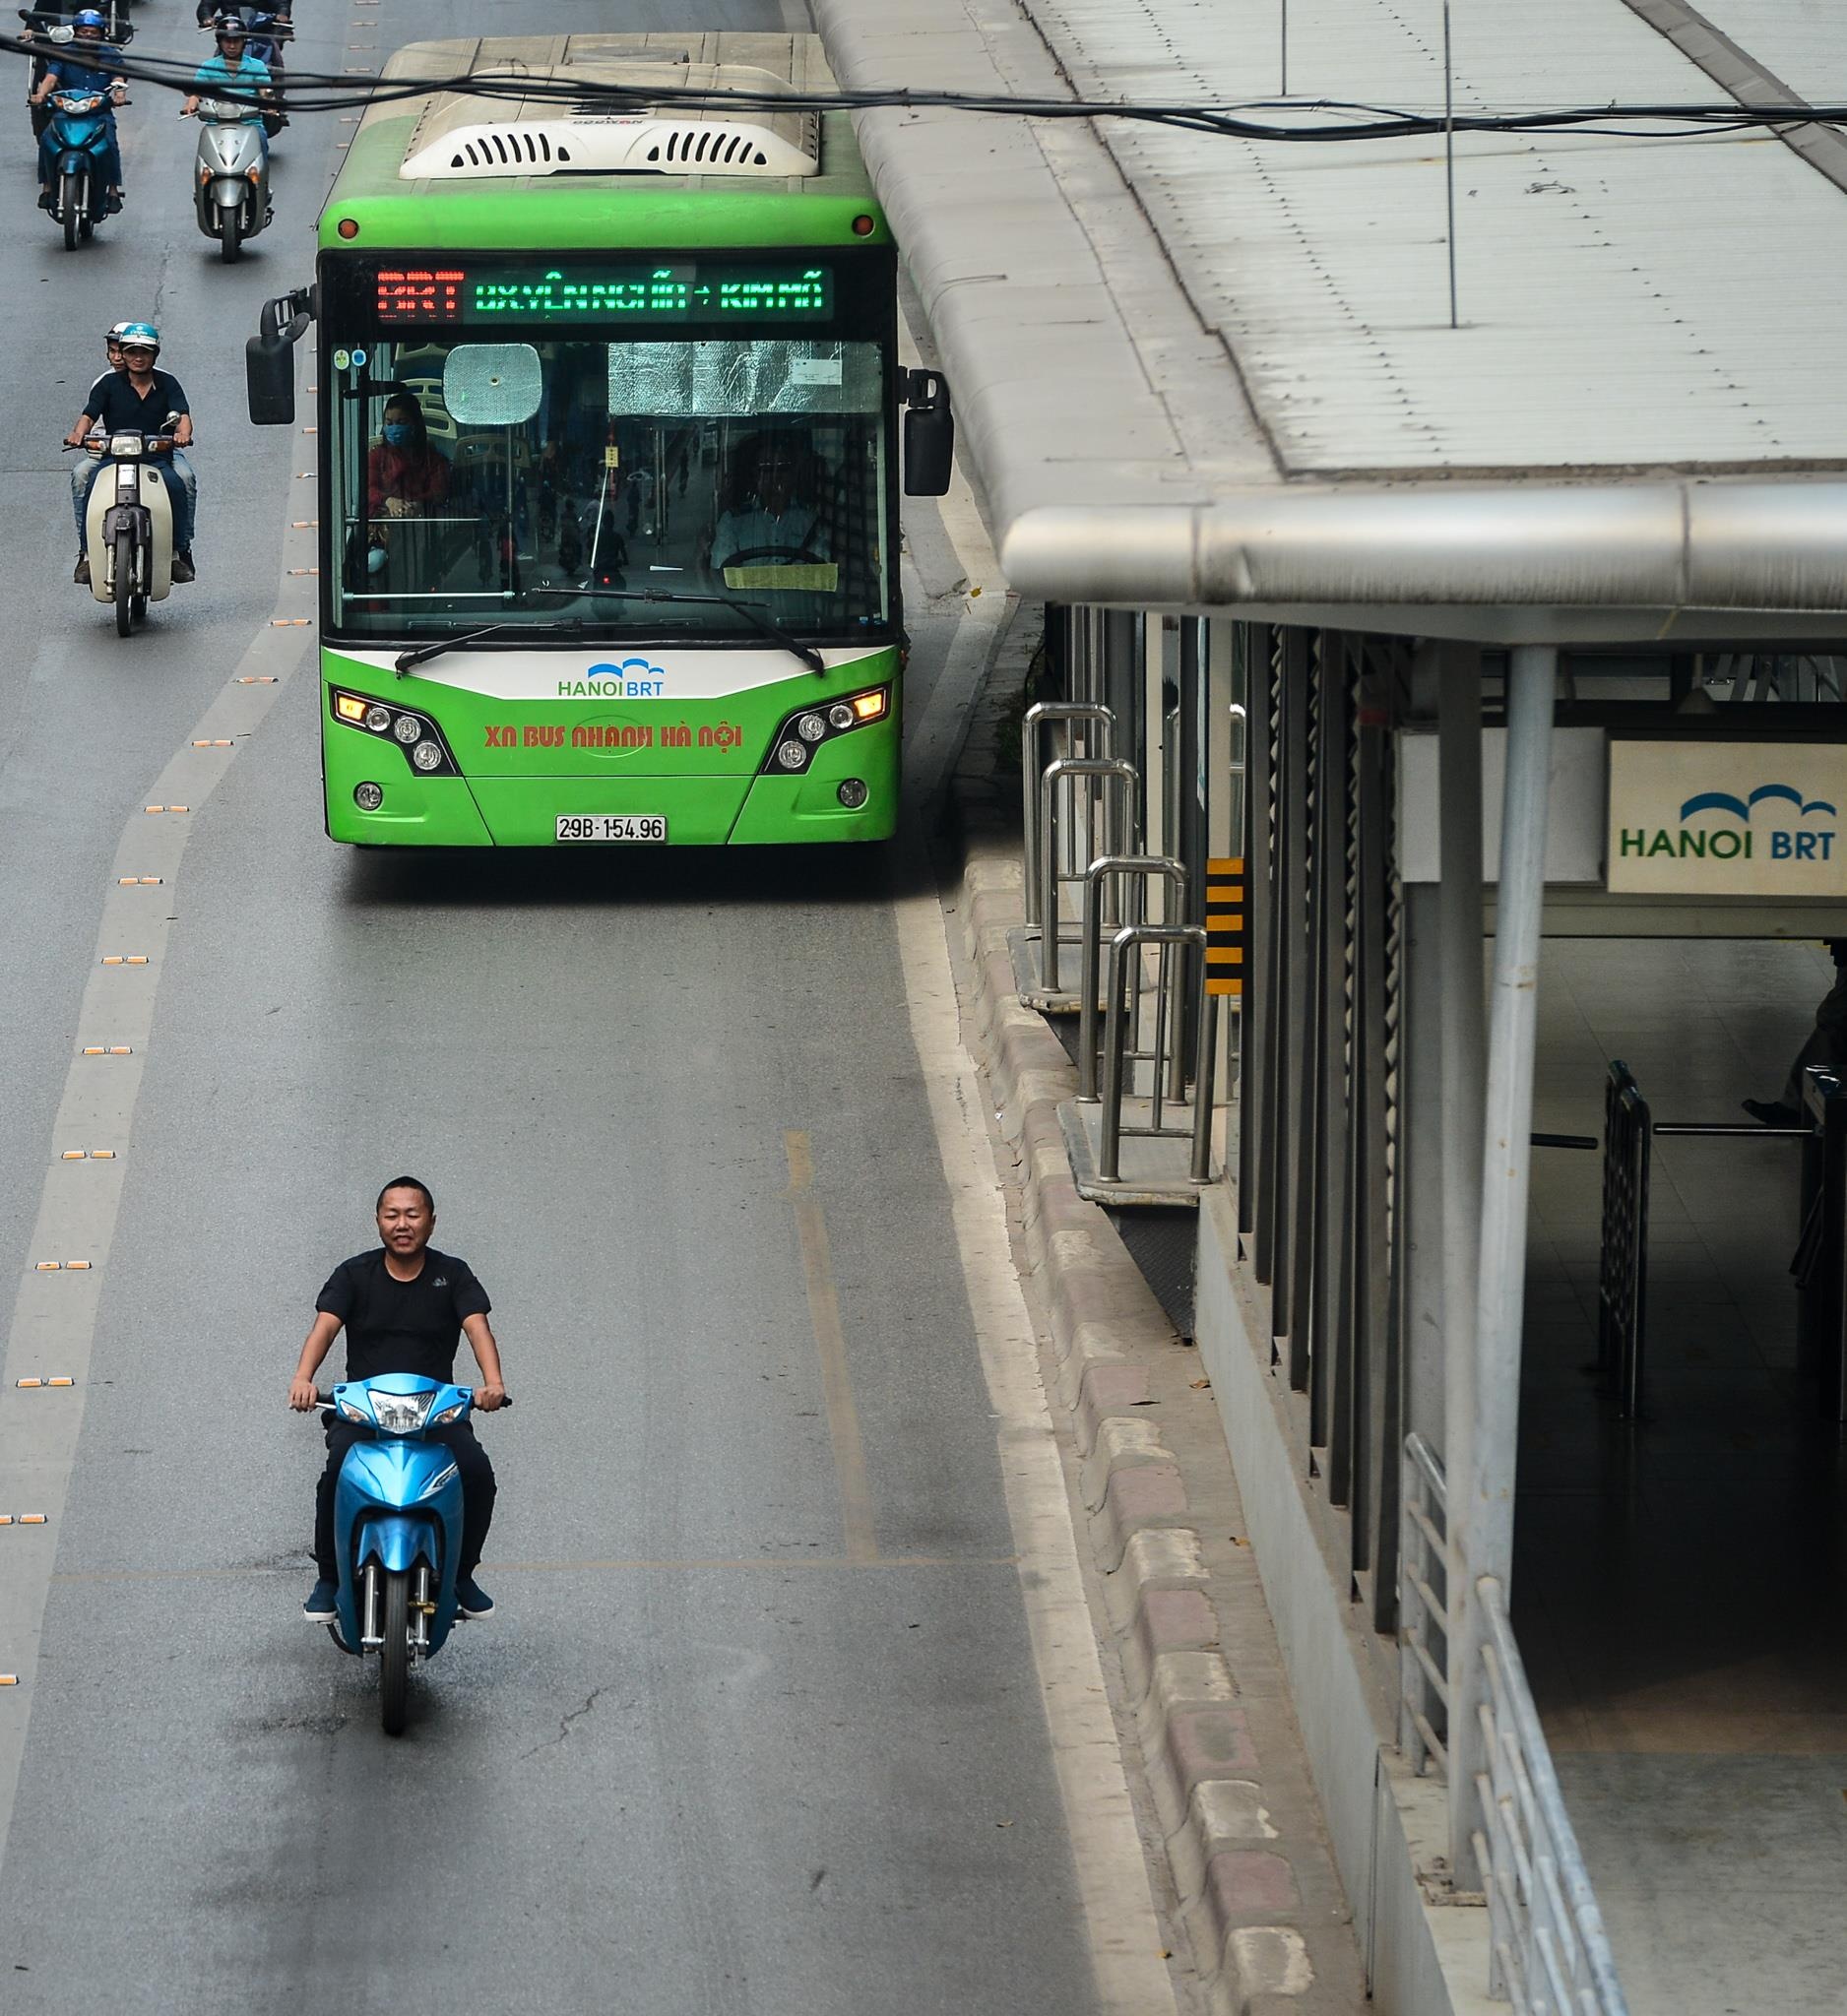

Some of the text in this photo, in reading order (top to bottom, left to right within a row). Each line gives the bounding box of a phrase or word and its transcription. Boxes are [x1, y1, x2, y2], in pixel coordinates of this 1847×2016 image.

[377, 271, 465, 318] BRT
[557, 681, 665, 697] HANOI BRT
[523, 725, 566, 748] BUS
[661, 720, 692, 748] HÀ
[1621, 829, 1836, 860] HANOI BRT
